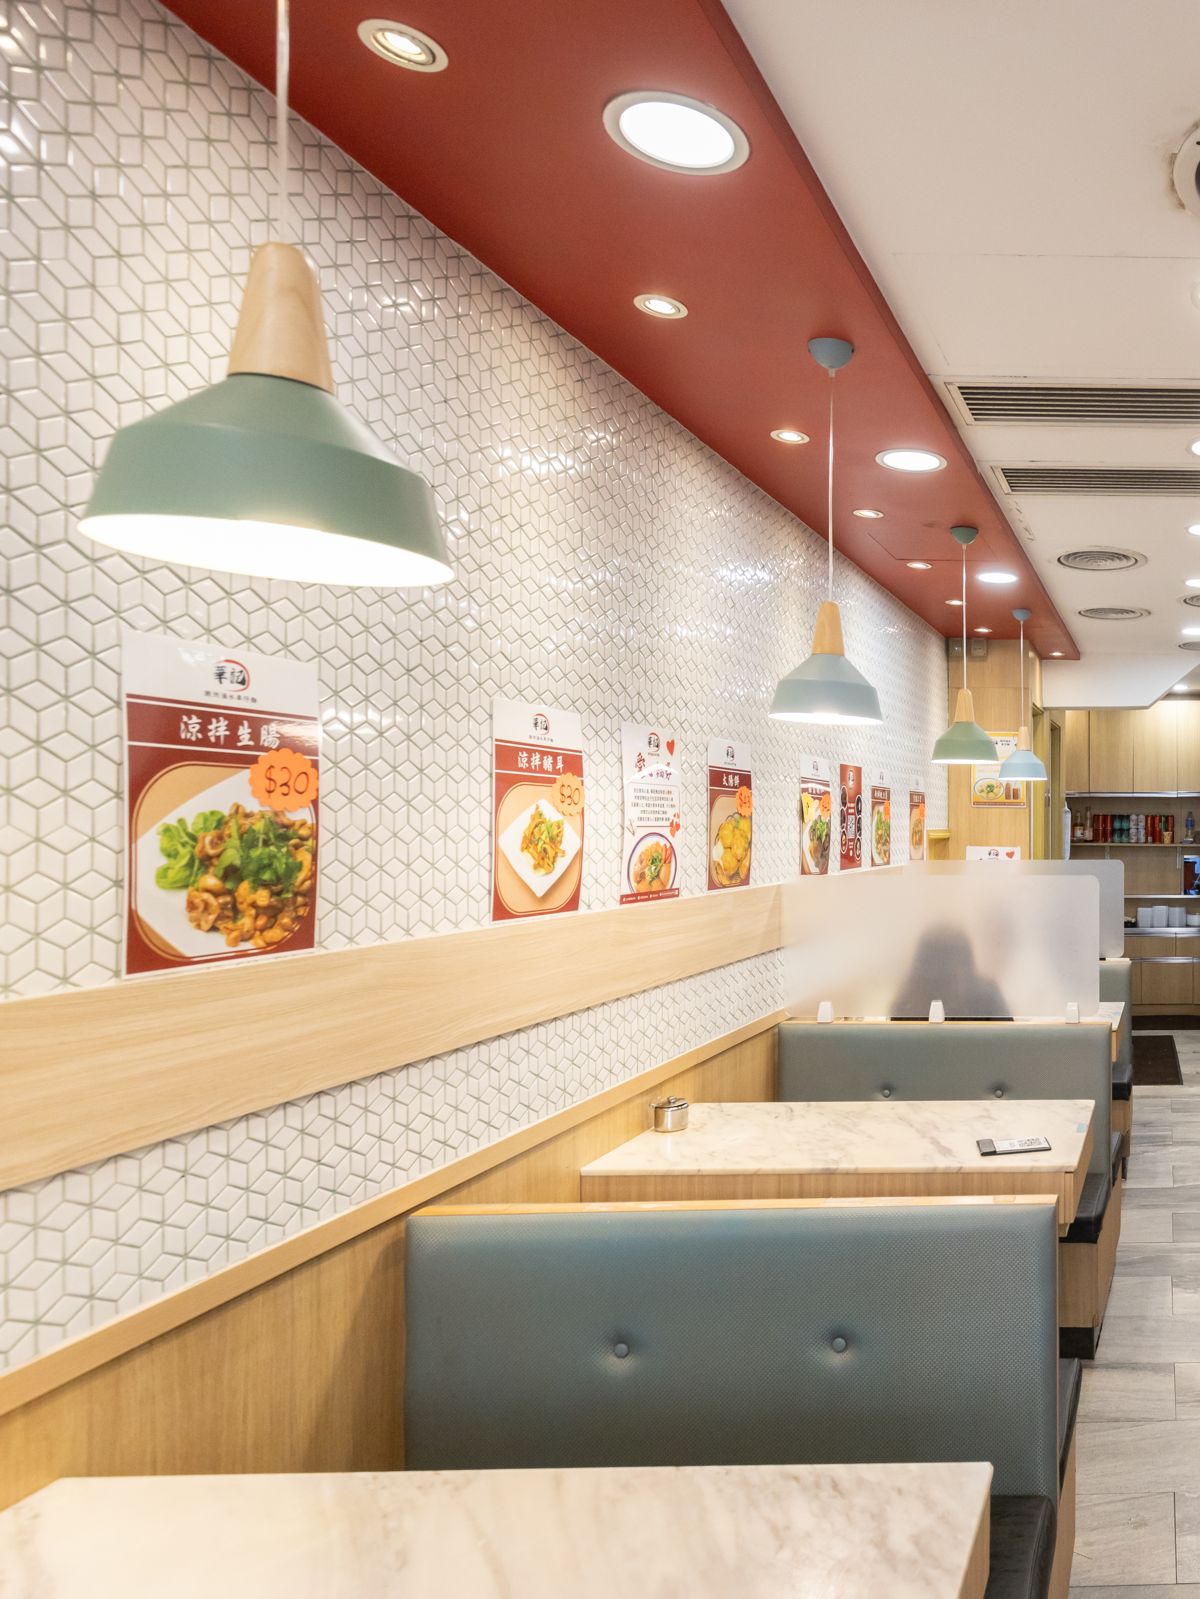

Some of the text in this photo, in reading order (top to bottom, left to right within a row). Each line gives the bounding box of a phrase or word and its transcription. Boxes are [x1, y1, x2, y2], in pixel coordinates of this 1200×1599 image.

[213, 665, 247, 687] 華記
[180, 715, 281, 749] 涼拌生腸
[517, 751, 564, 773] 涼拌豬耳
[264, 764, 310, 798] $30
[559, 784, 581, 806] $30
